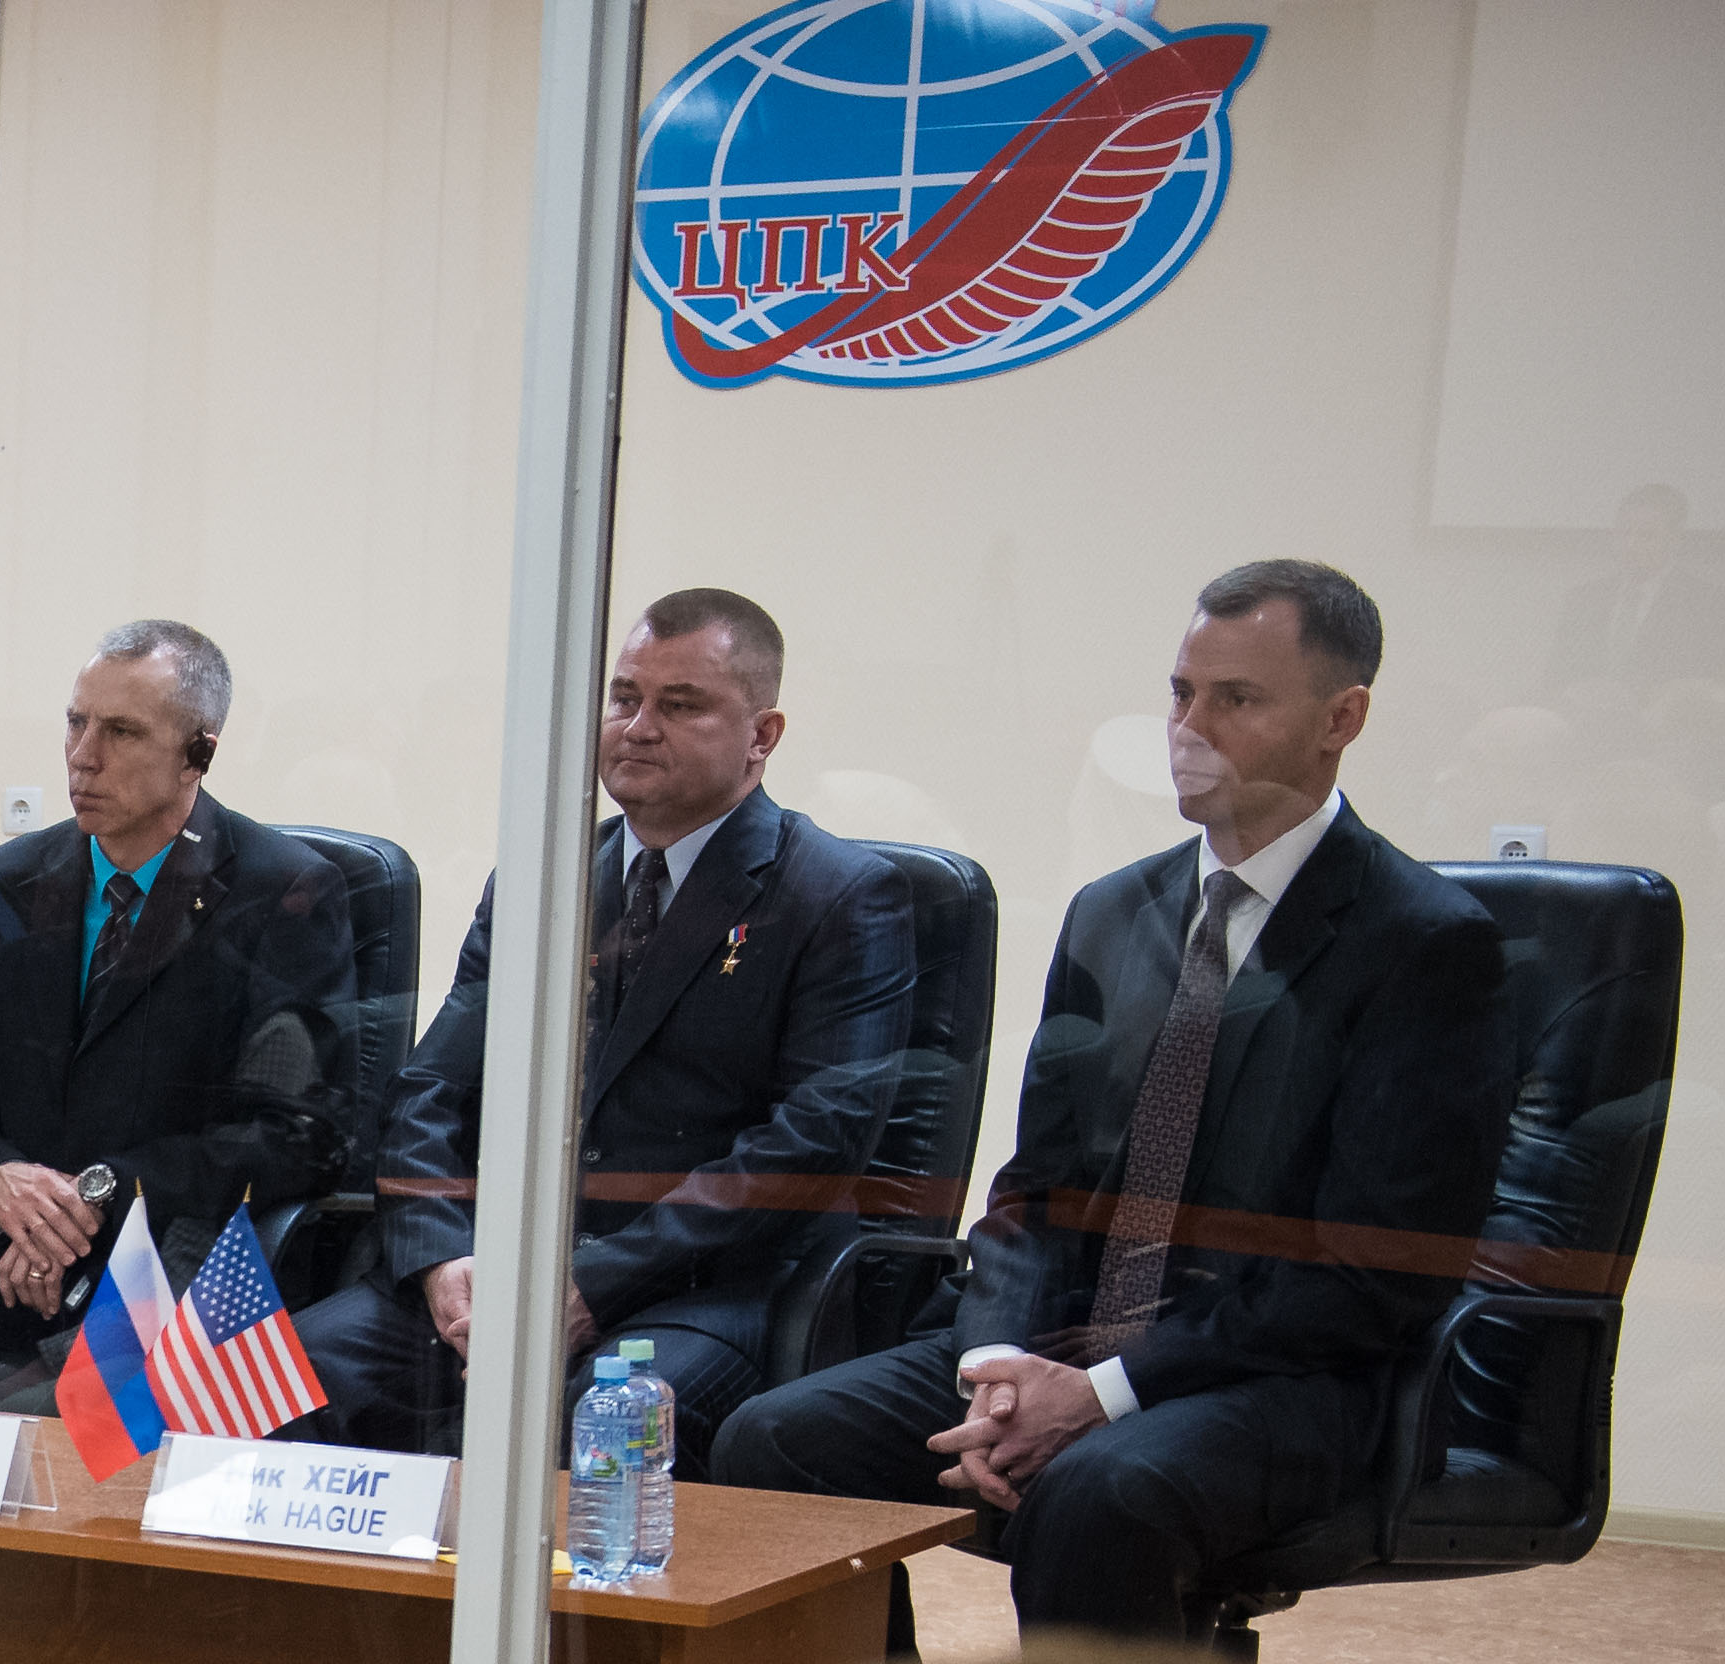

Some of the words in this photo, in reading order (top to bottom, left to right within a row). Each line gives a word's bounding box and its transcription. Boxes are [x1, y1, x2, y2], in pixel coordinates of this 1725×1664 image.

[672, 212, 910, 310] ЦПК
[302, 1463, 391, 1498] ХЕЙГ
[284, 1501, 387, 1537] HAGUE
